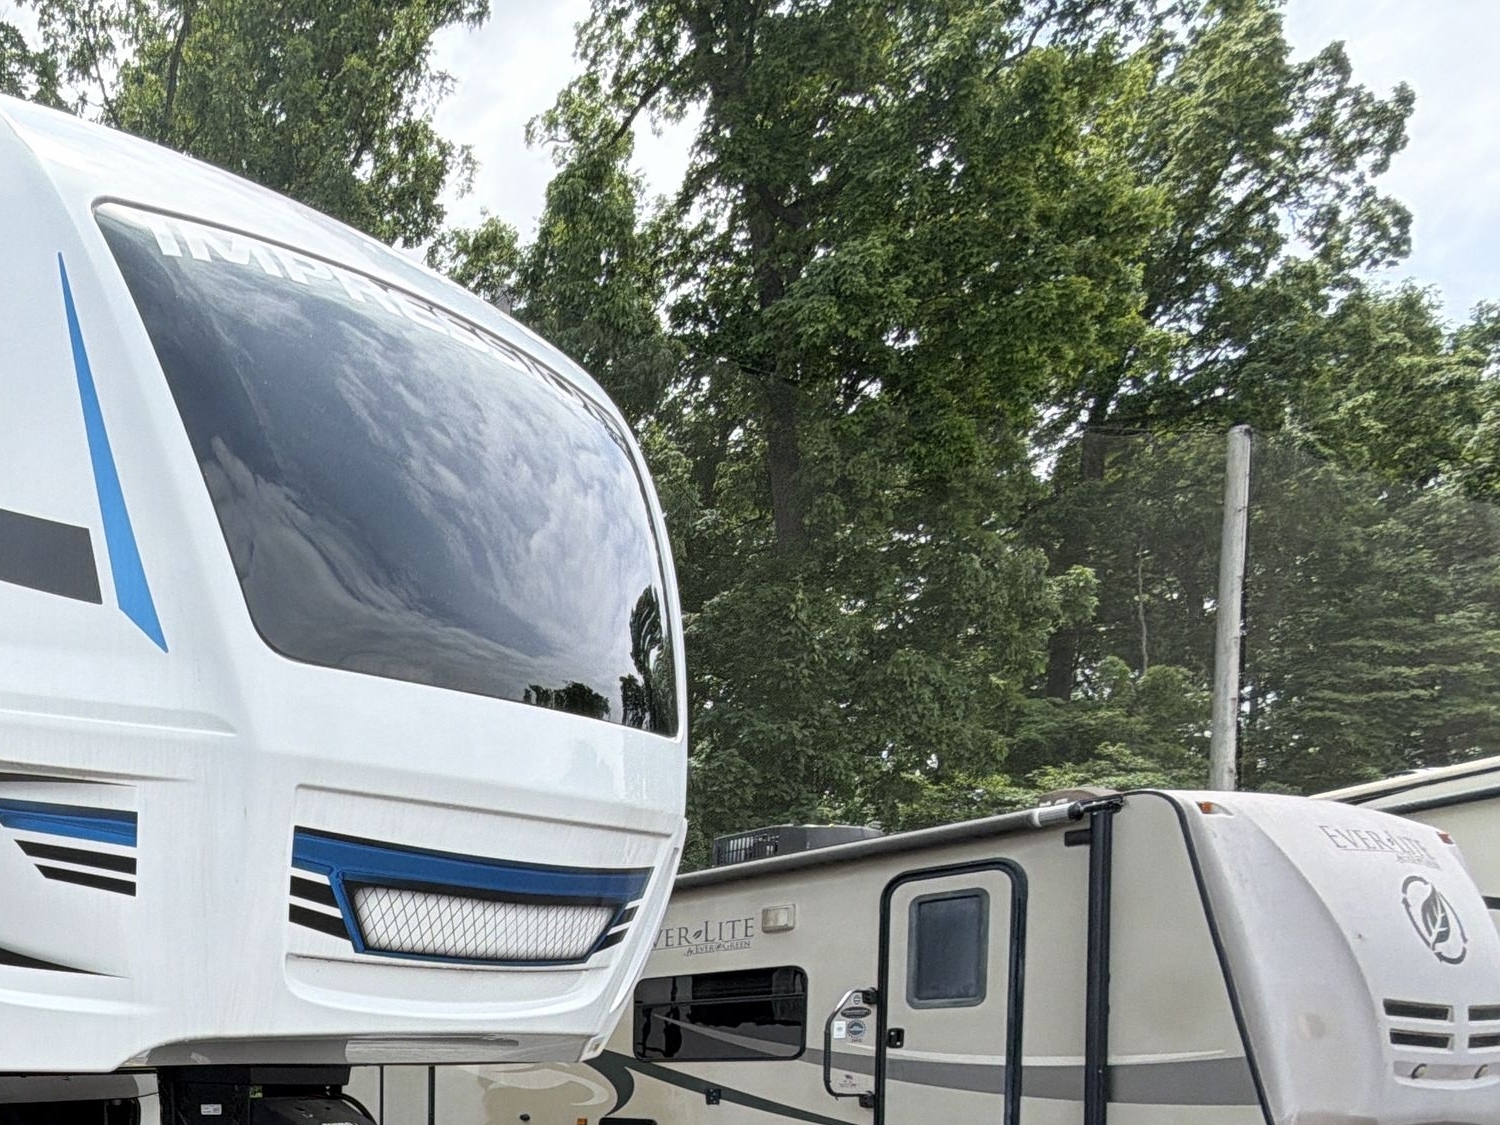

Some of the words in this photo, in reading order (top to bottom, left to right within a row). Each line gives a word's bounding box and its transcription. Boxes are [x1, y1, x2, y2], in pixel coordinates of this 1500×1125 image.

[1319, 825, 1393, 850] EVER
[654, 926, 691, 948] VER
[704, 918, 754, 942] LITE
